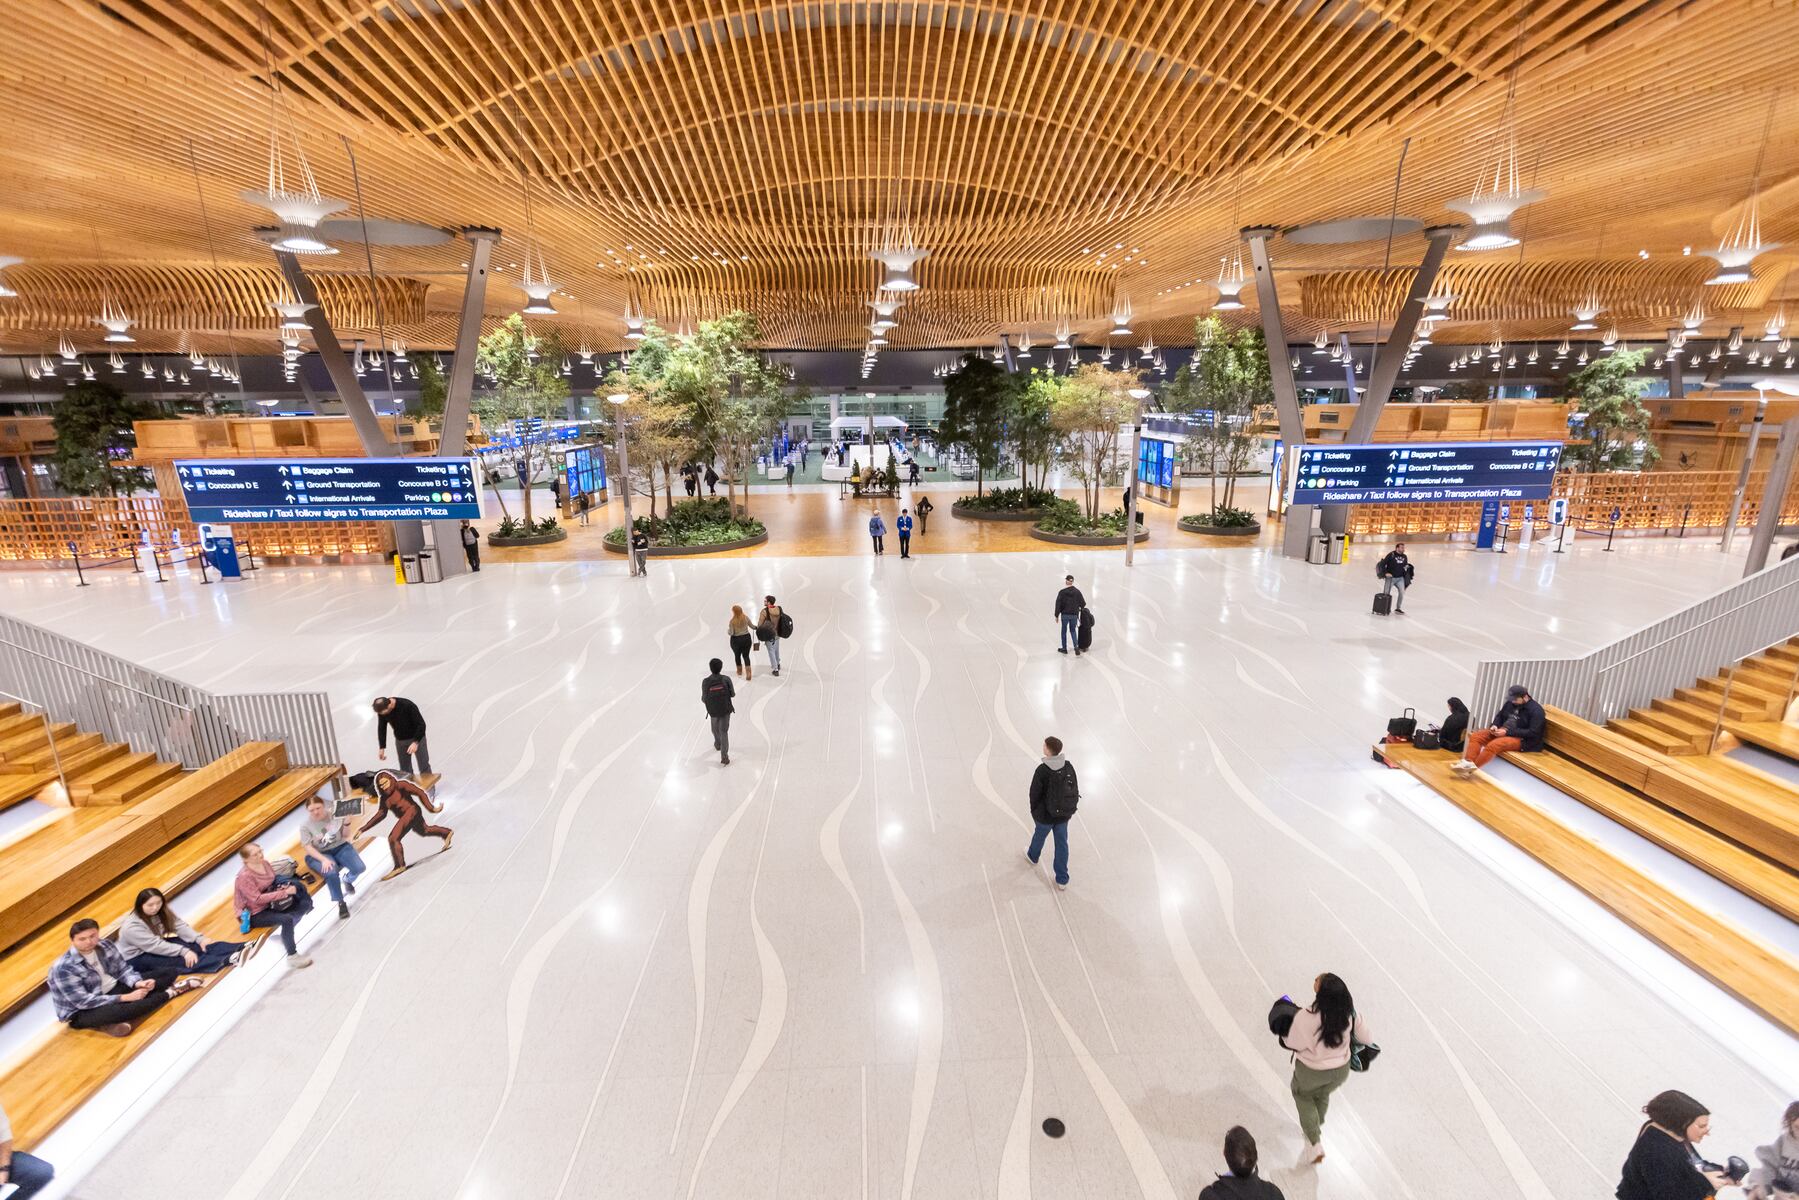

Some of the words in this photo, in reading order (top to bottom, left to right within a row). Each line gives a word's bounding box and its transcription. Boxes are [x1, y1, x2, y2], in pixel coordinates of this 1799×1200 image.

[1324, 452, 1351, 460] Ticketing
[1410, 451, 1438, 459] Baggage
[1512, 449, 1538, 457] Ticketing
[203, 468, 236, 476] Ticketing
[302, 467, 333, 476] Baggage
[416, 466, 446, 474] Ticketing
[1432, 464, 1474, 472] Transportation
[332, 481, 380, 489] Transportation
[404, 494, 430, 502] Parking
[1323, 492, 1362, 500] Rideshare
[1370, 492, 1385, 500] Taxi
[1386, 490, 1410, 499] follow
[1412, 491, 1432, 500] signs
[1444, 490, 1499, 499] Transportation
[1500, 489, 1522, 497] Plaza
[222, 510, 268, 518] Rideshare
[275, 509, 294, 518] Taxi
[295, 508, 321, 517] follow
[323, 508, 347, 518] signs
[348, 508, 358, 516] to
[359, 508, 422, 518] Transportation
[424, 507, 448, 516] Plaza
